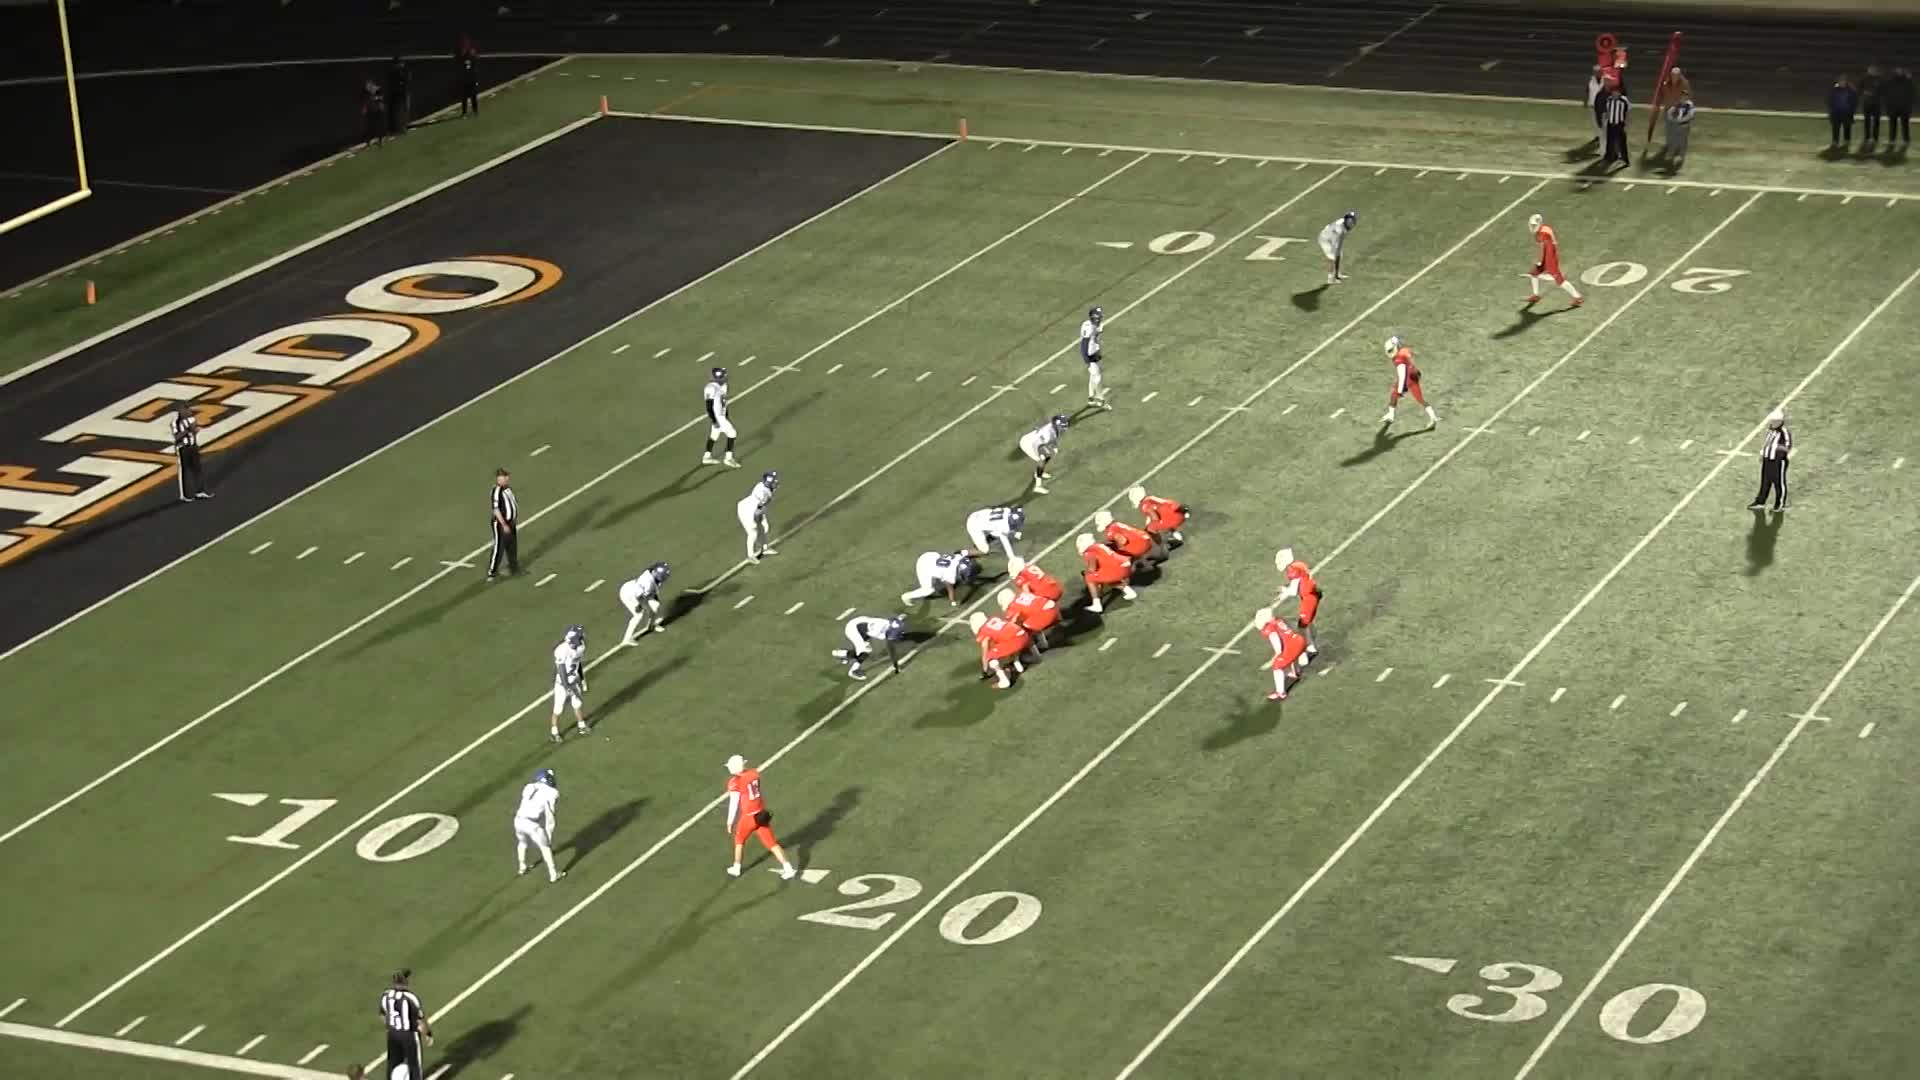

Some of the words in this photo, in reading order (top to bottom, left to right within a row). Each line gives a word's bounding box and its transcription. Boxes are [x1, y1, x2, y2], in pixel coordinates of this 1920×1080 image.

[0, 252, 562, 566] LEDO
[226, 798, 460, 862] 10
[797, 873, 1042, 945] 20
[1447, 961, 1707, 1044] 30
